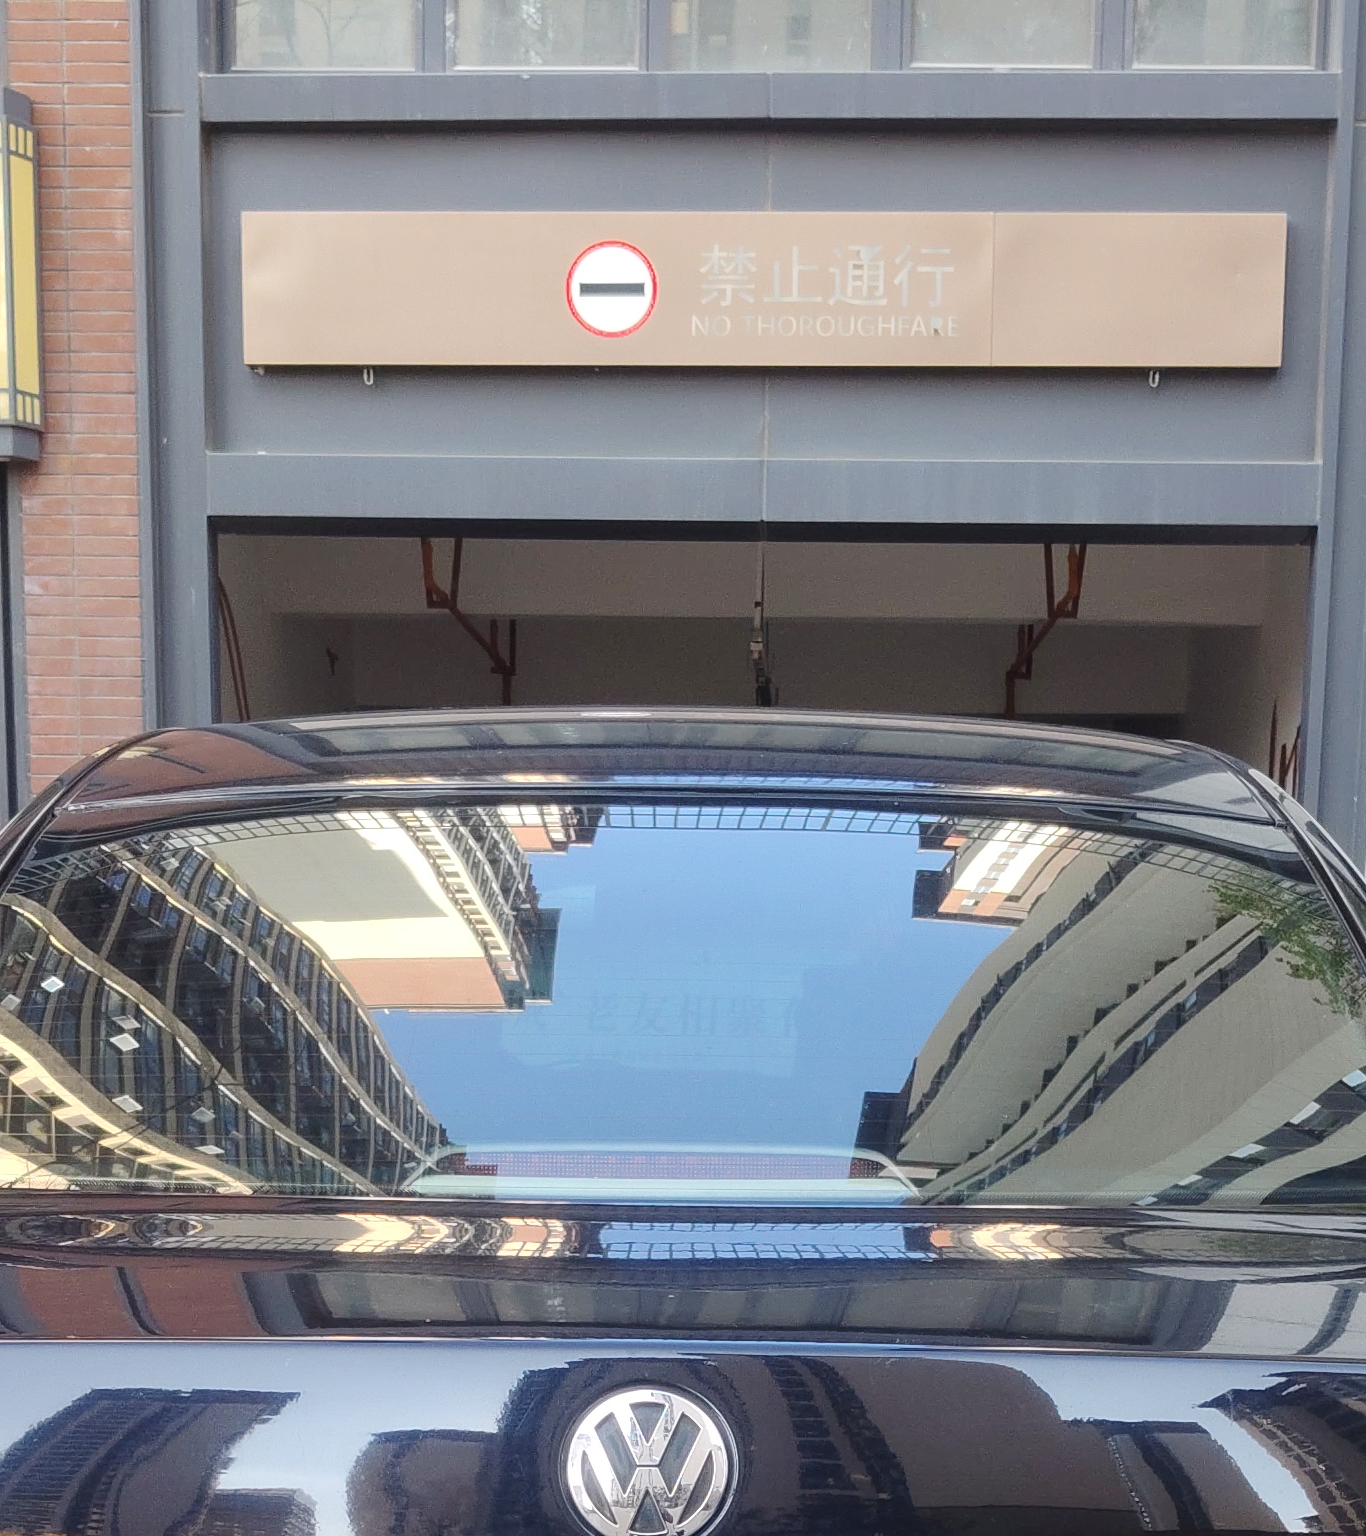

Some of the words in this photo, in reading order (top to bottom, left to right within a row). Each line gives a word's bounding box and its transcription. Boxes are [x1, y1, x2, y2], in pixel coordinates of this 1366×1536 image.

[699, 242, 955, 308] 禁止通行
[690, 314, 732, 338] NO
[741, 314, 961, 338] THOROUGHFARE
